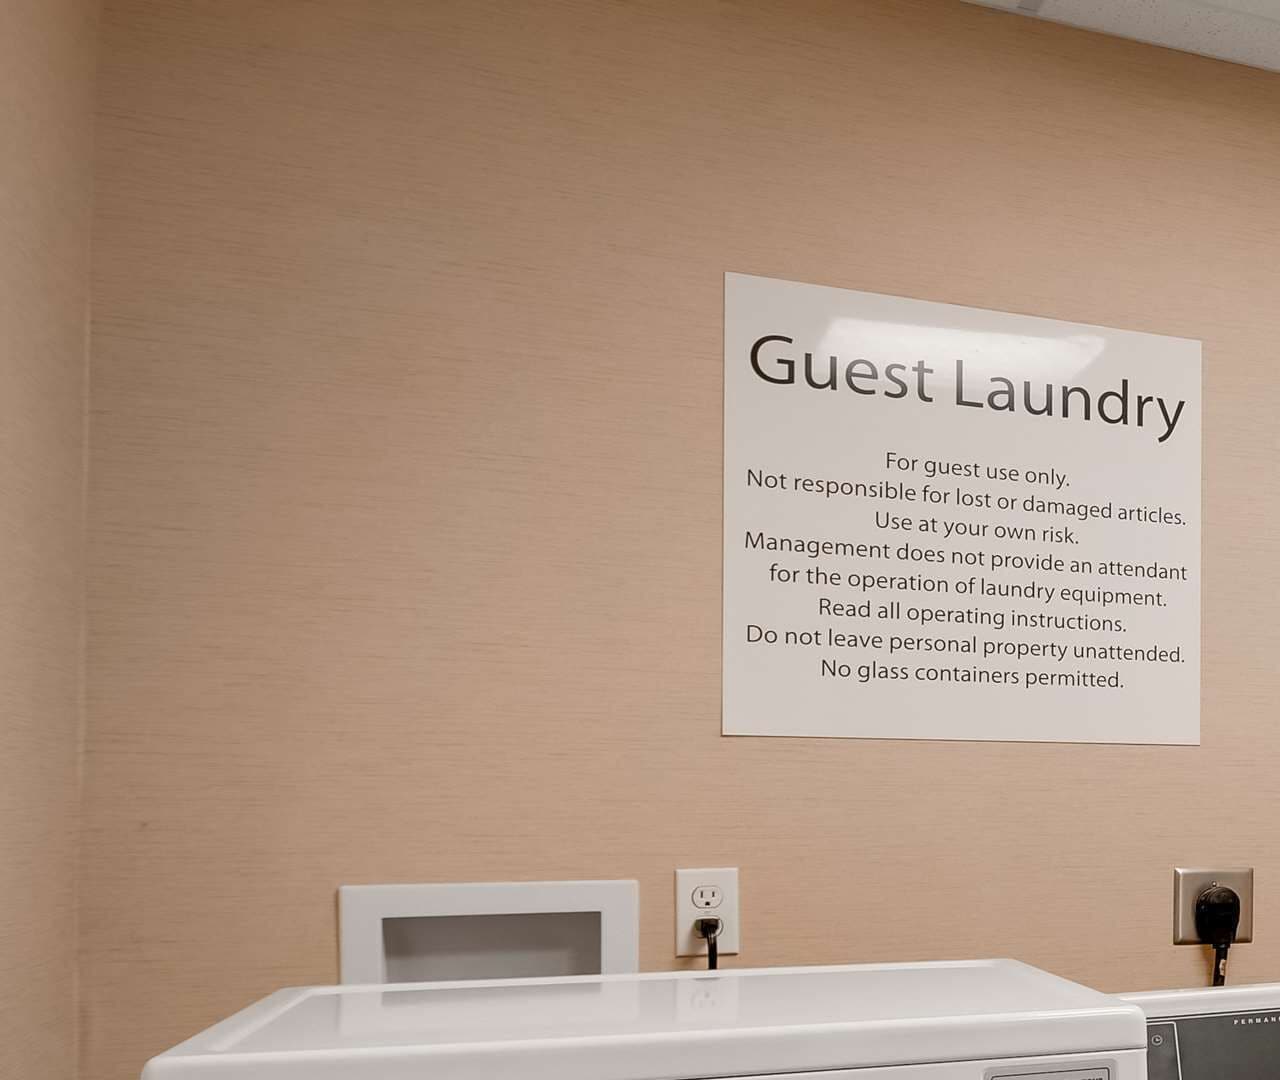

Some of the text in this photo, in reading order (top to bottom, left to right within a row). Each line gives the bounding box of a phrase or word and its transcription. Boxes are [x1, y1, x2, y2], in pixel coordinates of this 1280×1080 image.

[749, 334, 1186, 444] Guest Laundry
[886, 451, 1070, 491] For guest use only.
[747, 468, 1186, 526] Not responsible for lost or damaged articles.
[875, 510, 1079, 545] Use at your own risk.
[744, 530, 1188, 581] Management does not provide an attendant
[768, 562, 1167, 608] for the operation of laundry equipment.
[818, 597, 1127, 633] Read all operating instructions.
[746, 624, 1185, 664] Do not leave personal property unattended.
[821, 658, 1124, 689] No glass containers permitted.
